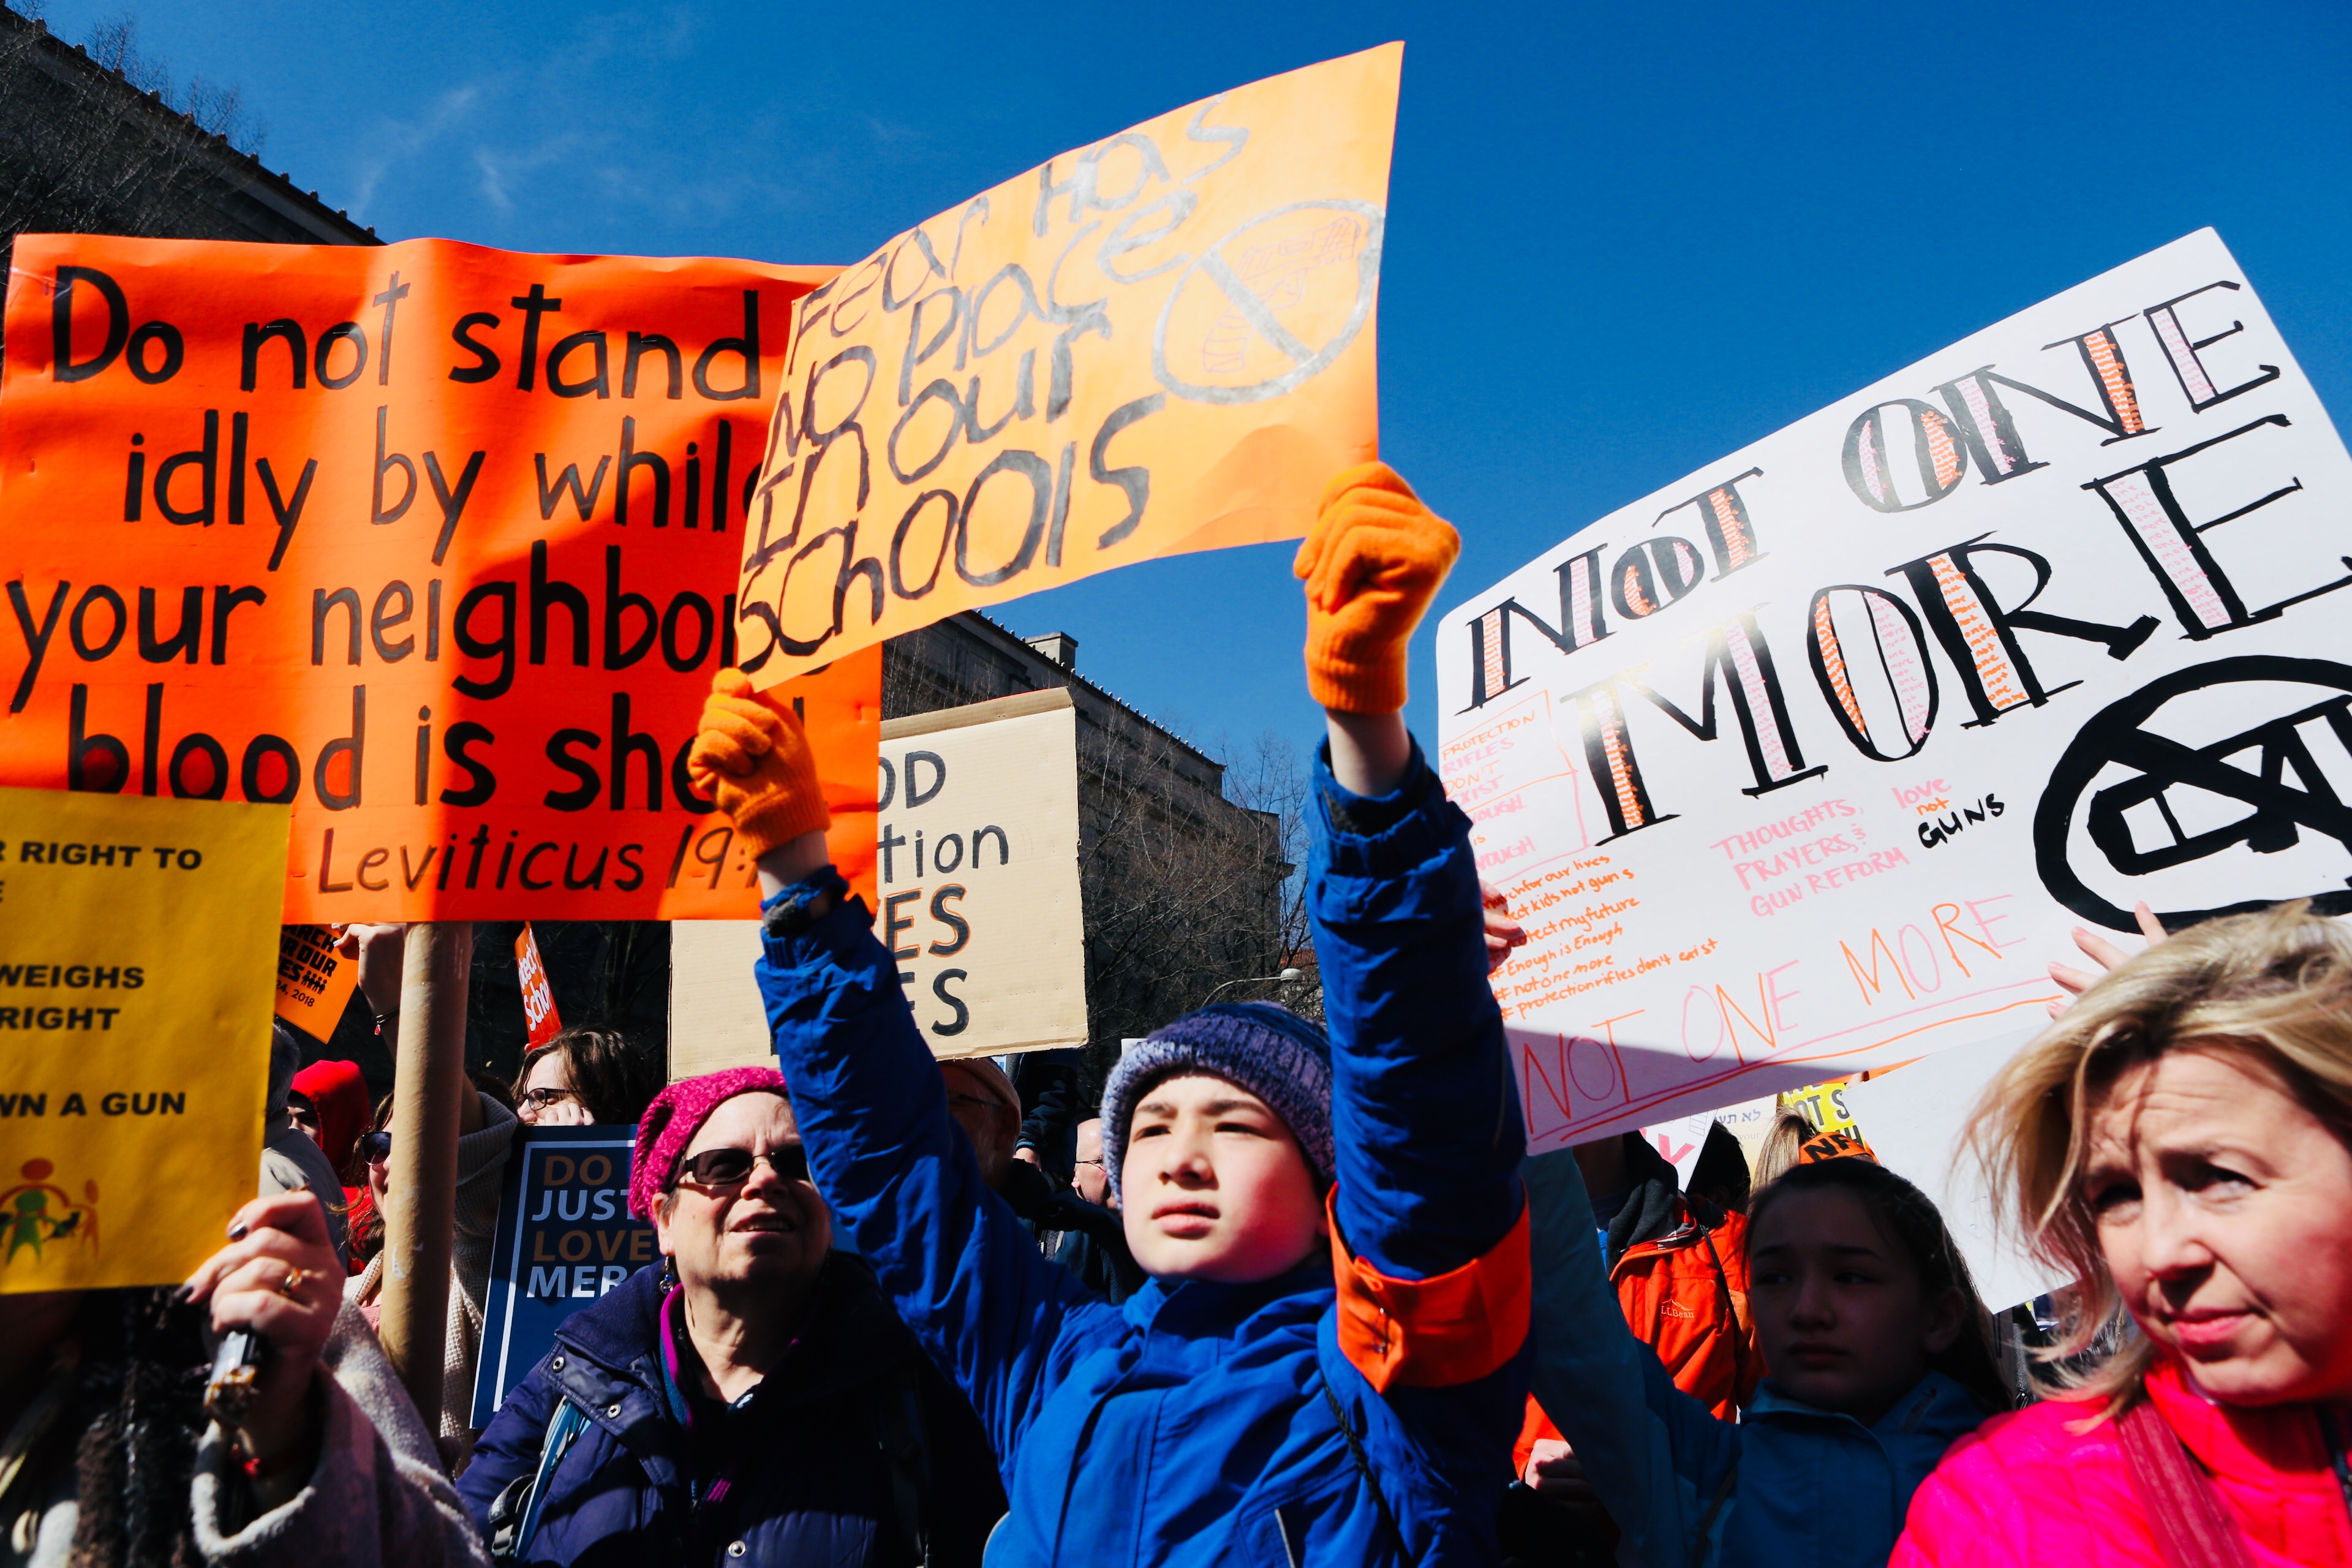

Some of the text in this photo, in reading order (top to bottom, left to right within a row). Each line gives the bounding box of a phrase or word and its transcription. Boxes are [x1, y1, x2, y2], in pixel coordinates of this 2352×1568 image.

[788, 194, 989, 376] Fear
[53, 265, 761, 401] Do not stand
[888, 311, 1111, 484] our
[124, 405, 764, 571] idly by whil
[1455, 467, 1770, 715] NOT
[1842, 280, 2280, 513] ONE
[6, 579, 267, 713] your
[1559, 414, 2352, 846] MORE
[68, 683, 365, 811] blood
[415, 705, 496, 807] is
[1442, 713, 1535, 761] PROTECTION
[1442, 737, 1514, 775] RIFLES
[1442, 760, 1500, 796] DON'T
[1891, 778, 1952, 809] love
[1917, 797, 1950, 815] not
[1918, 793, 2005, 848] GUNS
[20, 842, 141, 867] RIGHT
[153, 848, 203, 870] TO
[1472, 834, 1486, 846] is
[318, 824, 758, 894] Leviticus 19:
[1545, 867, 1570, 882] our
[1573, 856, 1610, 871] lives
[1530, 893, 1561, 912] kids
[1560, 880, 1586, 898] not
[1750, 846, 1910, 917] GUN REFORM
[1559, 943, 1572, 956] is
[1574, 922, 1624, 949] Enough
[297, 944, 337, 978] OUR
[1573, 954, 1615, 974] more
[291, 989, 315, 1007] 2018
[1523, 894, 2027, 1135] NOT ONE MORE
[59, 1093, 87, 1117] A
[100, 1092, 186, 1116] GUN
[543, 1155, 612, 1186] DO
[533, 1229, 652, 1262] LOVE
[527, 1264, 651, 1299] MER
